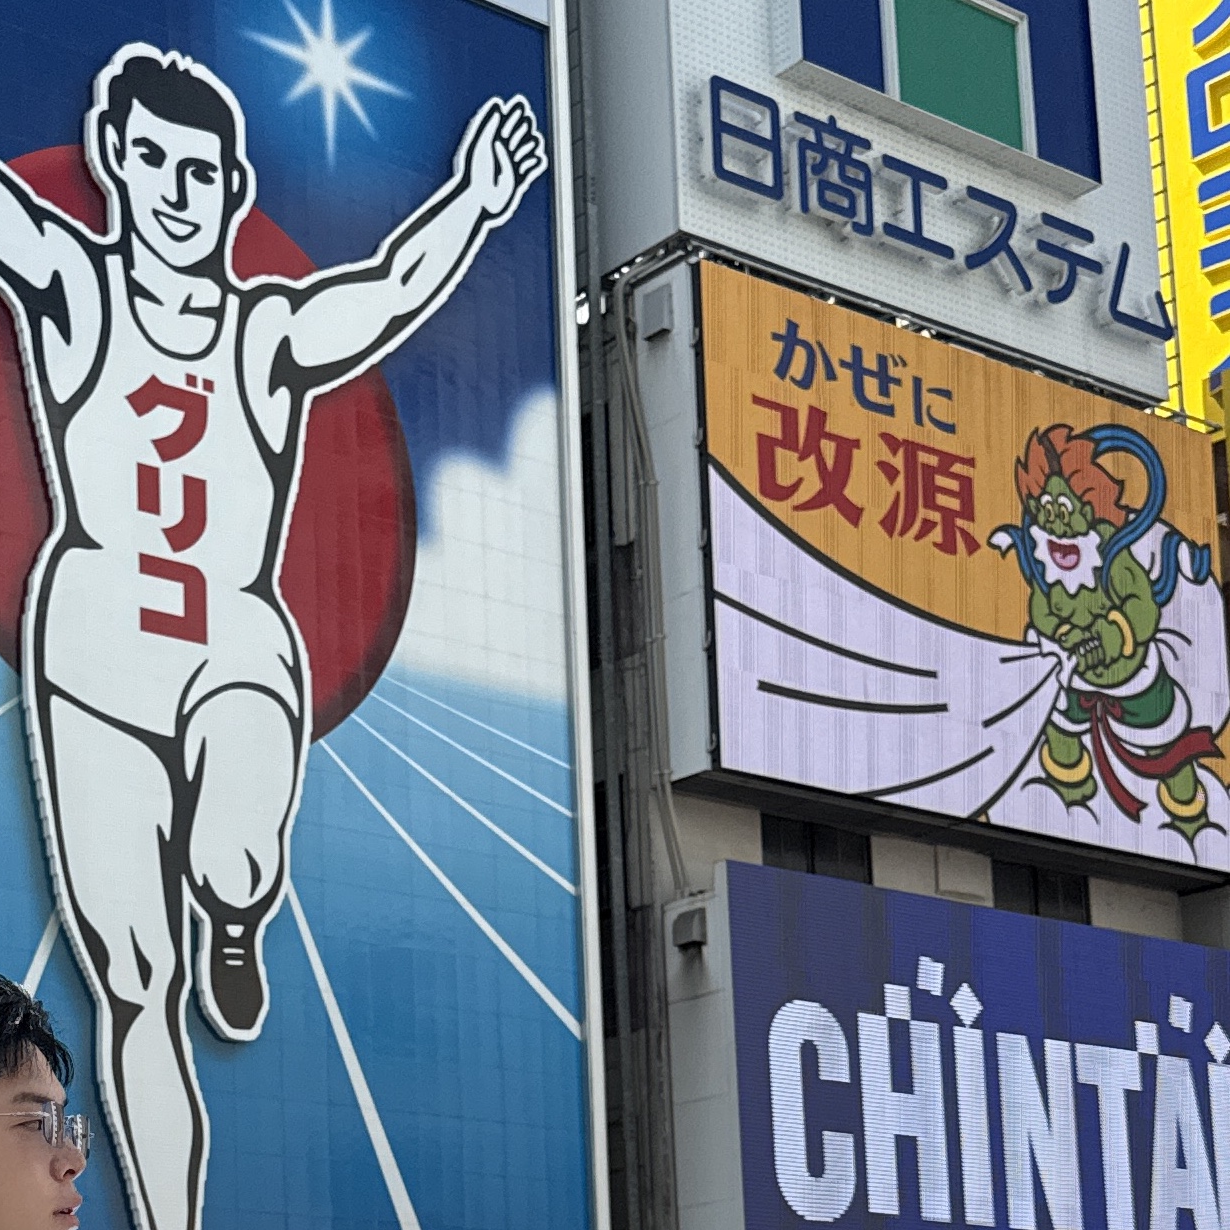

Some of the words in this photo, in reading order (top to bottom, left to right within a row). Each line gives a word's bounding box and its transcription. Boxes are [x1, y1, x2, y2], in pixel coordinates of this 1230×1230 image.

[710, 75, 1174, 342] 日商エステム
[752, 394, 981, 556] 改源
[771, 318, 956, 434] かぜに
[125, 373, 215, 646] グリコ
